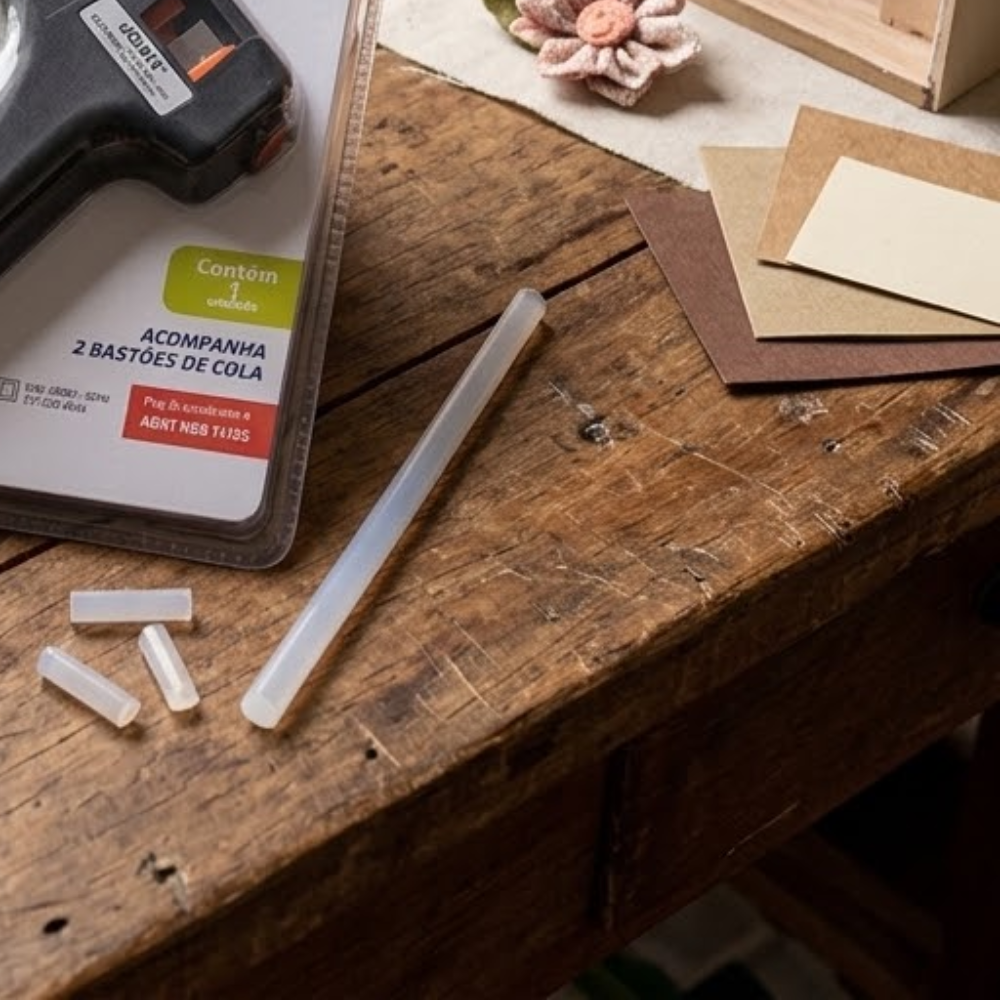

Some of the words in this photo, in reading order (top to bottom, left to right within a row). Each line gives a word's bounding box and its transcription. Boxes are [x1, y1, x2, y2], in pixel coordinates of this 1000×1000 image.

[72, 340, 85, 356] 2
[181, 355, 207, 373] DE
[211, 360, 263, 381] COLA
[140, 327, 267, 360] ACOMPANHA
